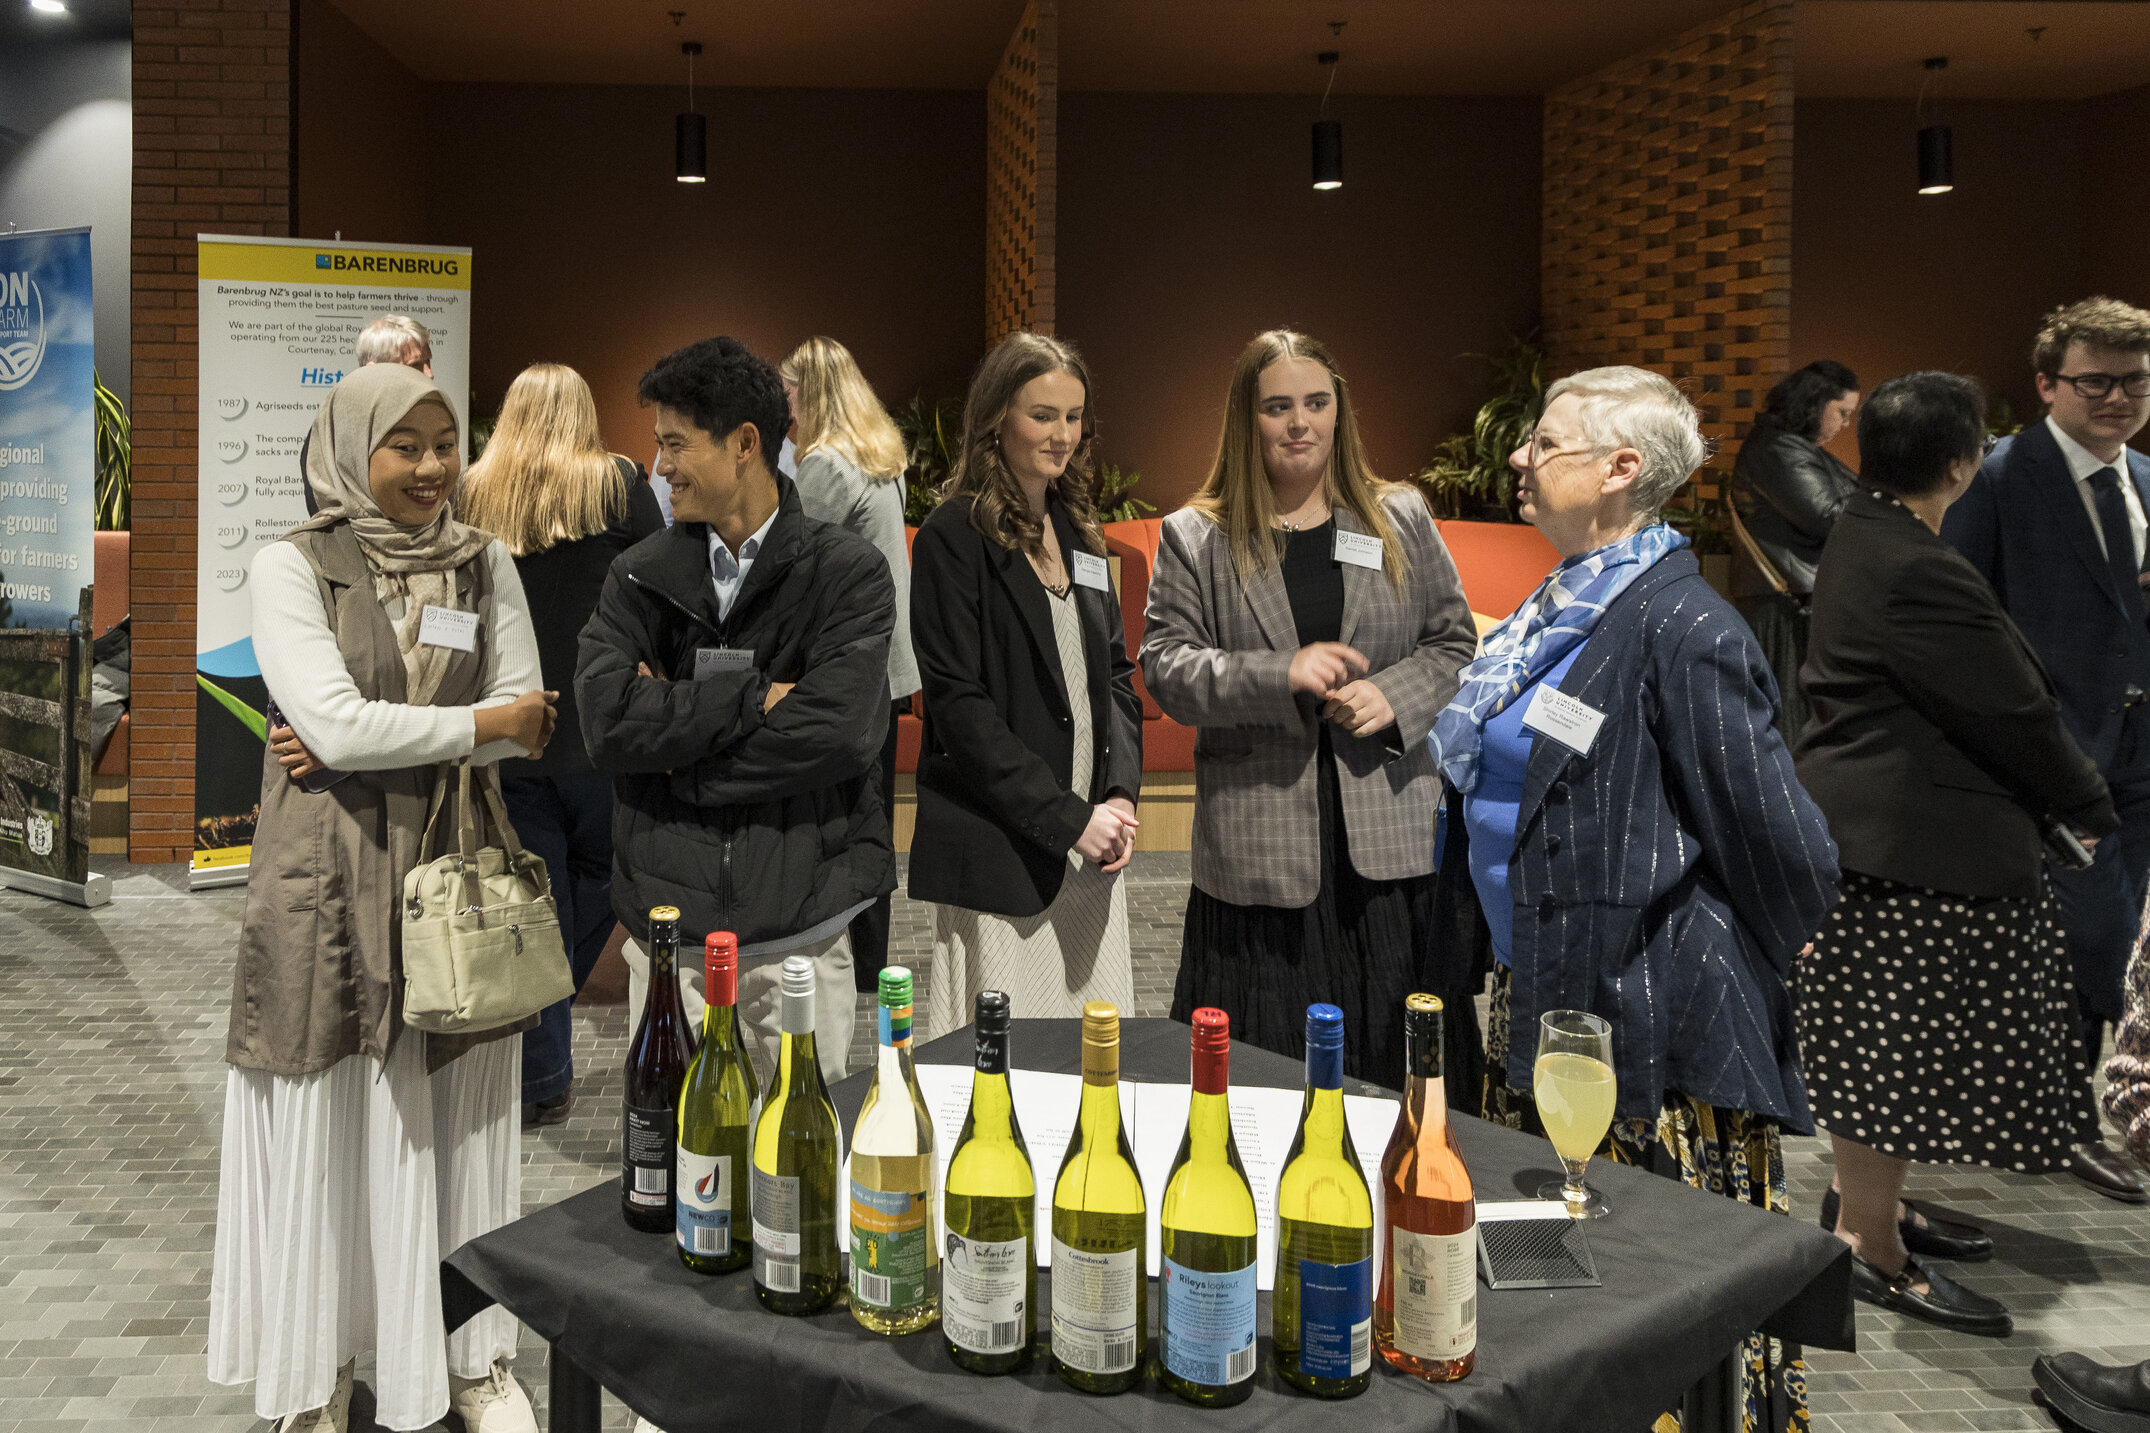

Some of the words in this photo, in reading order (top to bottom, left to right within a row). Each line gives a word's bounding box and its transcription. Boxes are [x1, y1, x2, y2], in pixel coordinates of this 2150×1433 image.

[334, 255, 458, 275] BARENBRUG
[217, 286, 266, 297] Barenbrug
[269, 287, 290, 297] NZ's
[292, 289, 312, 299] goal
[314, 290, 321, 298] is
[324, 290, 333, 298] to
[336, 291, 355, 300] help
[358, 291, 391, 300] farmers
[394, 293, 419, 301] thrive
[427, 295, 459, 305] through
[229, 299, 271, 309] providing
[274, 300, 296, 308] them
[299, 301, 313, 309] the
[315, 301, 334, 310] best
[337, 303, 368, 311] pasture
[371, 303, 391, 312] seed
[393, 304, 409, 312] and
[411, 305, 445, 314] support.
[229, 321, 244, 329] We
[264, 323, 283, 331] part
[298, 323, 312, 331] the
[315, 324, 344, 333] global
[428, 328, 448, 336] roup
[230, 334, 276, 343] operating
[279, 334, 300, 342] from
[320, 335, 337, 343] 225
[287, 345, 336, 356] Courtenay,
[301, 367, 344, 385] Hist
[218, 399, 241, 408] 1987
[256, 402, 304, 412] Agriseeds
[218, 442, 241, 451] 1996
[256, 434, 274, 443] The
[255, 448, 281, 457] sacks
[284, 449, 299, 457] are
[1, 477, 68, 505] providing
[218, 484, 242, 494] 2007
[255, 476, 281, 486] Royal
[255, 487, 275, 497] fully
[0, 513, 58, 537] -ground
[218, 528, 241, 537] 2011
[255, 519, 299, 528] Rolleston
[21, 545, 79, 571] farmers
[217, 570, 241, 579] 2023
[1556, 701, 1593, 721] UNIVERSITY
[1557, 697, 1583, 712] LINCOLN
[688, 1210, 715, 1222] NEWCO
[1068, 1251, 1110, 1265] Cottesbrook
[1179, 1274, 1206, 1289] Rileys
[1207, 1281, 1239, 1290] lookout
[1189, 1289, 1214, 1299] Sauvignon
